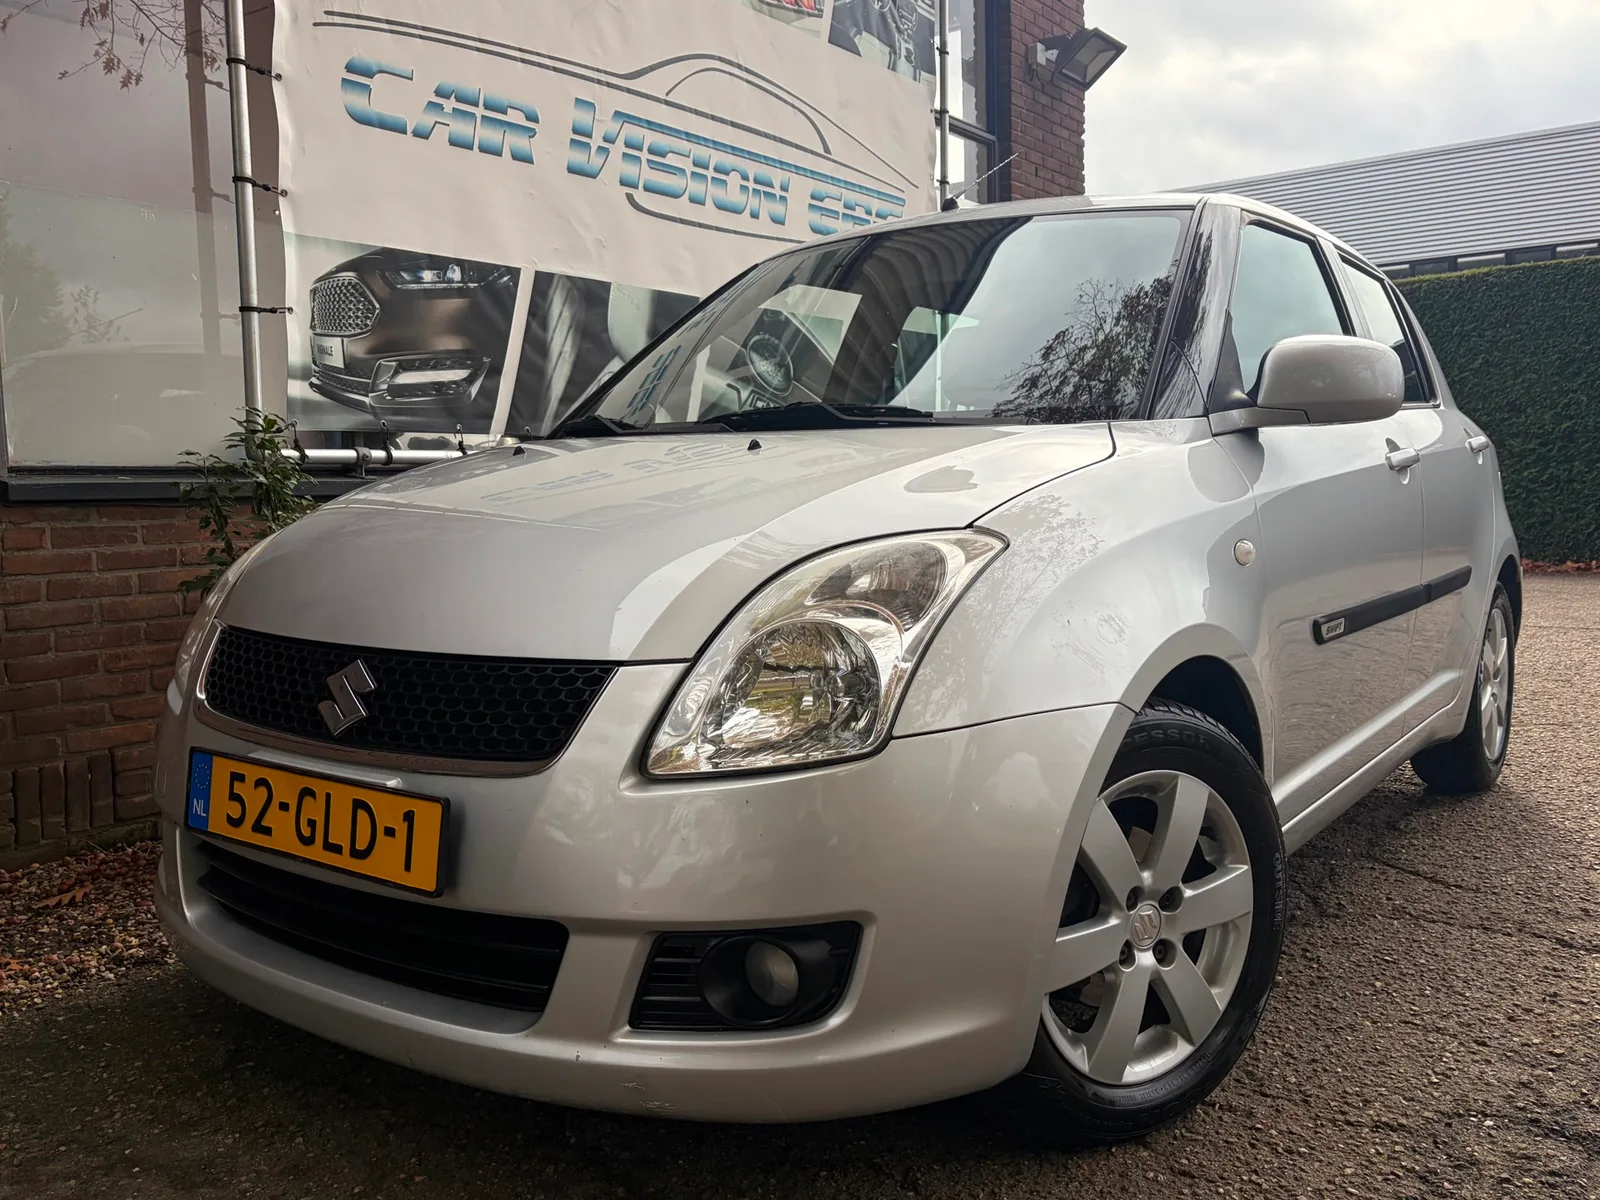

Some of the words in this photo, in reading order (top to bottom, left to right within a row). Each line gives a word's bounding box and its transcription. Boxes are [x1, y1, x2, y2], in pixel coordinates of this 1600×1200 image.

[341, 55, 540, 165] CAR
[567, 97, 791, 226] VISION
[193, 798, 207, 817] NL
[226, 770, 416, 873] 52-GLD-1
